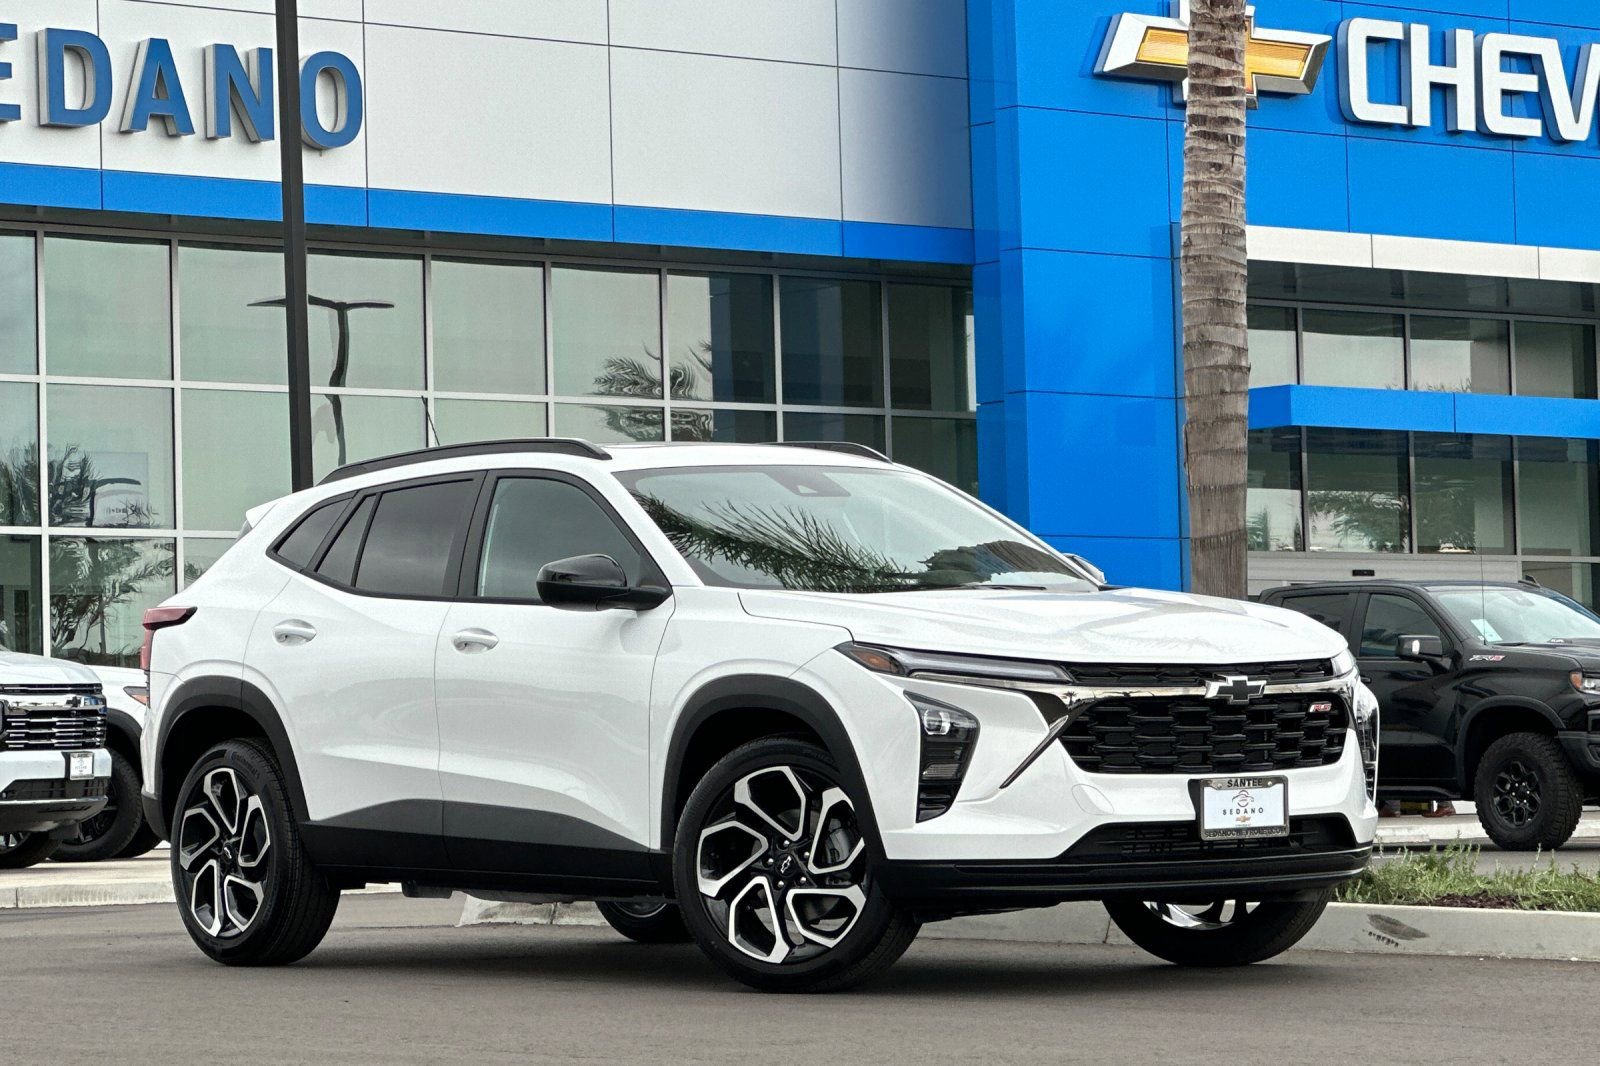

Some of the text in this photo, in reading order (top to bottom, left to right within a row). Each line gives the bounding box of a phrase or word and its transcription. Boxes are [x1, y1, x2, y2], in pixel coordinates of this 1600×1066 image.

[1338, 17, 1600, 141] CHEV
[1226, 778, 1263, 788] SANTEE
[1222, 807, 1264, 816] SEDANO
